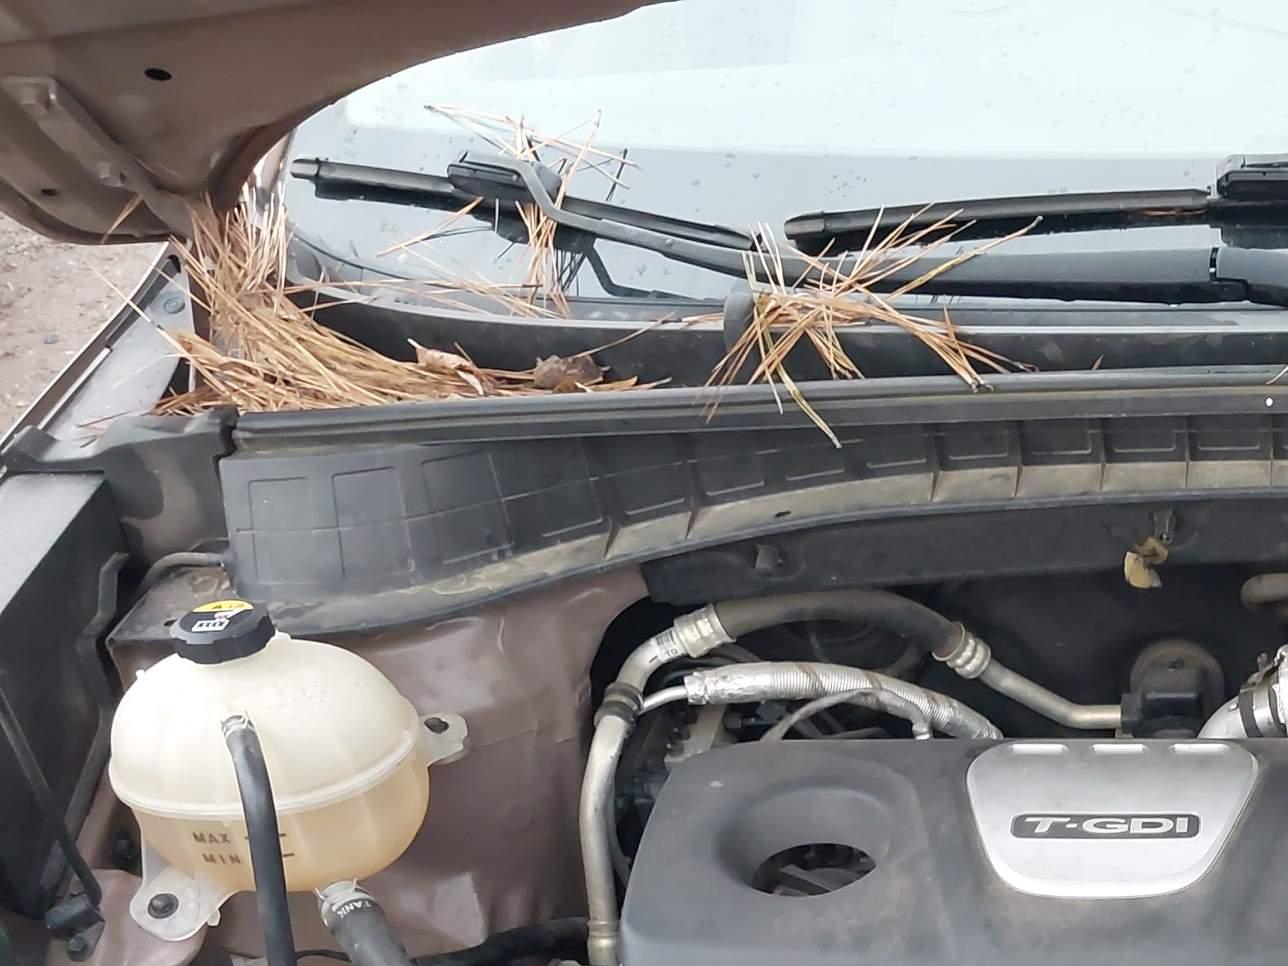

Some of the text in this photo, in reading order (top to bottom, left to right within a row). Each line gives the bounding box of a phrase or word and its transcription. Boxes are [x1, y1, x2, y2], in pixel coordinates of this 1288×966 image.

[1025, 817, 1189, 834] T-GDI
[192, 832, 231, 844] MAX
[202, 853, 241, 865] MIN
[337, 901, 373, 919] TANK
